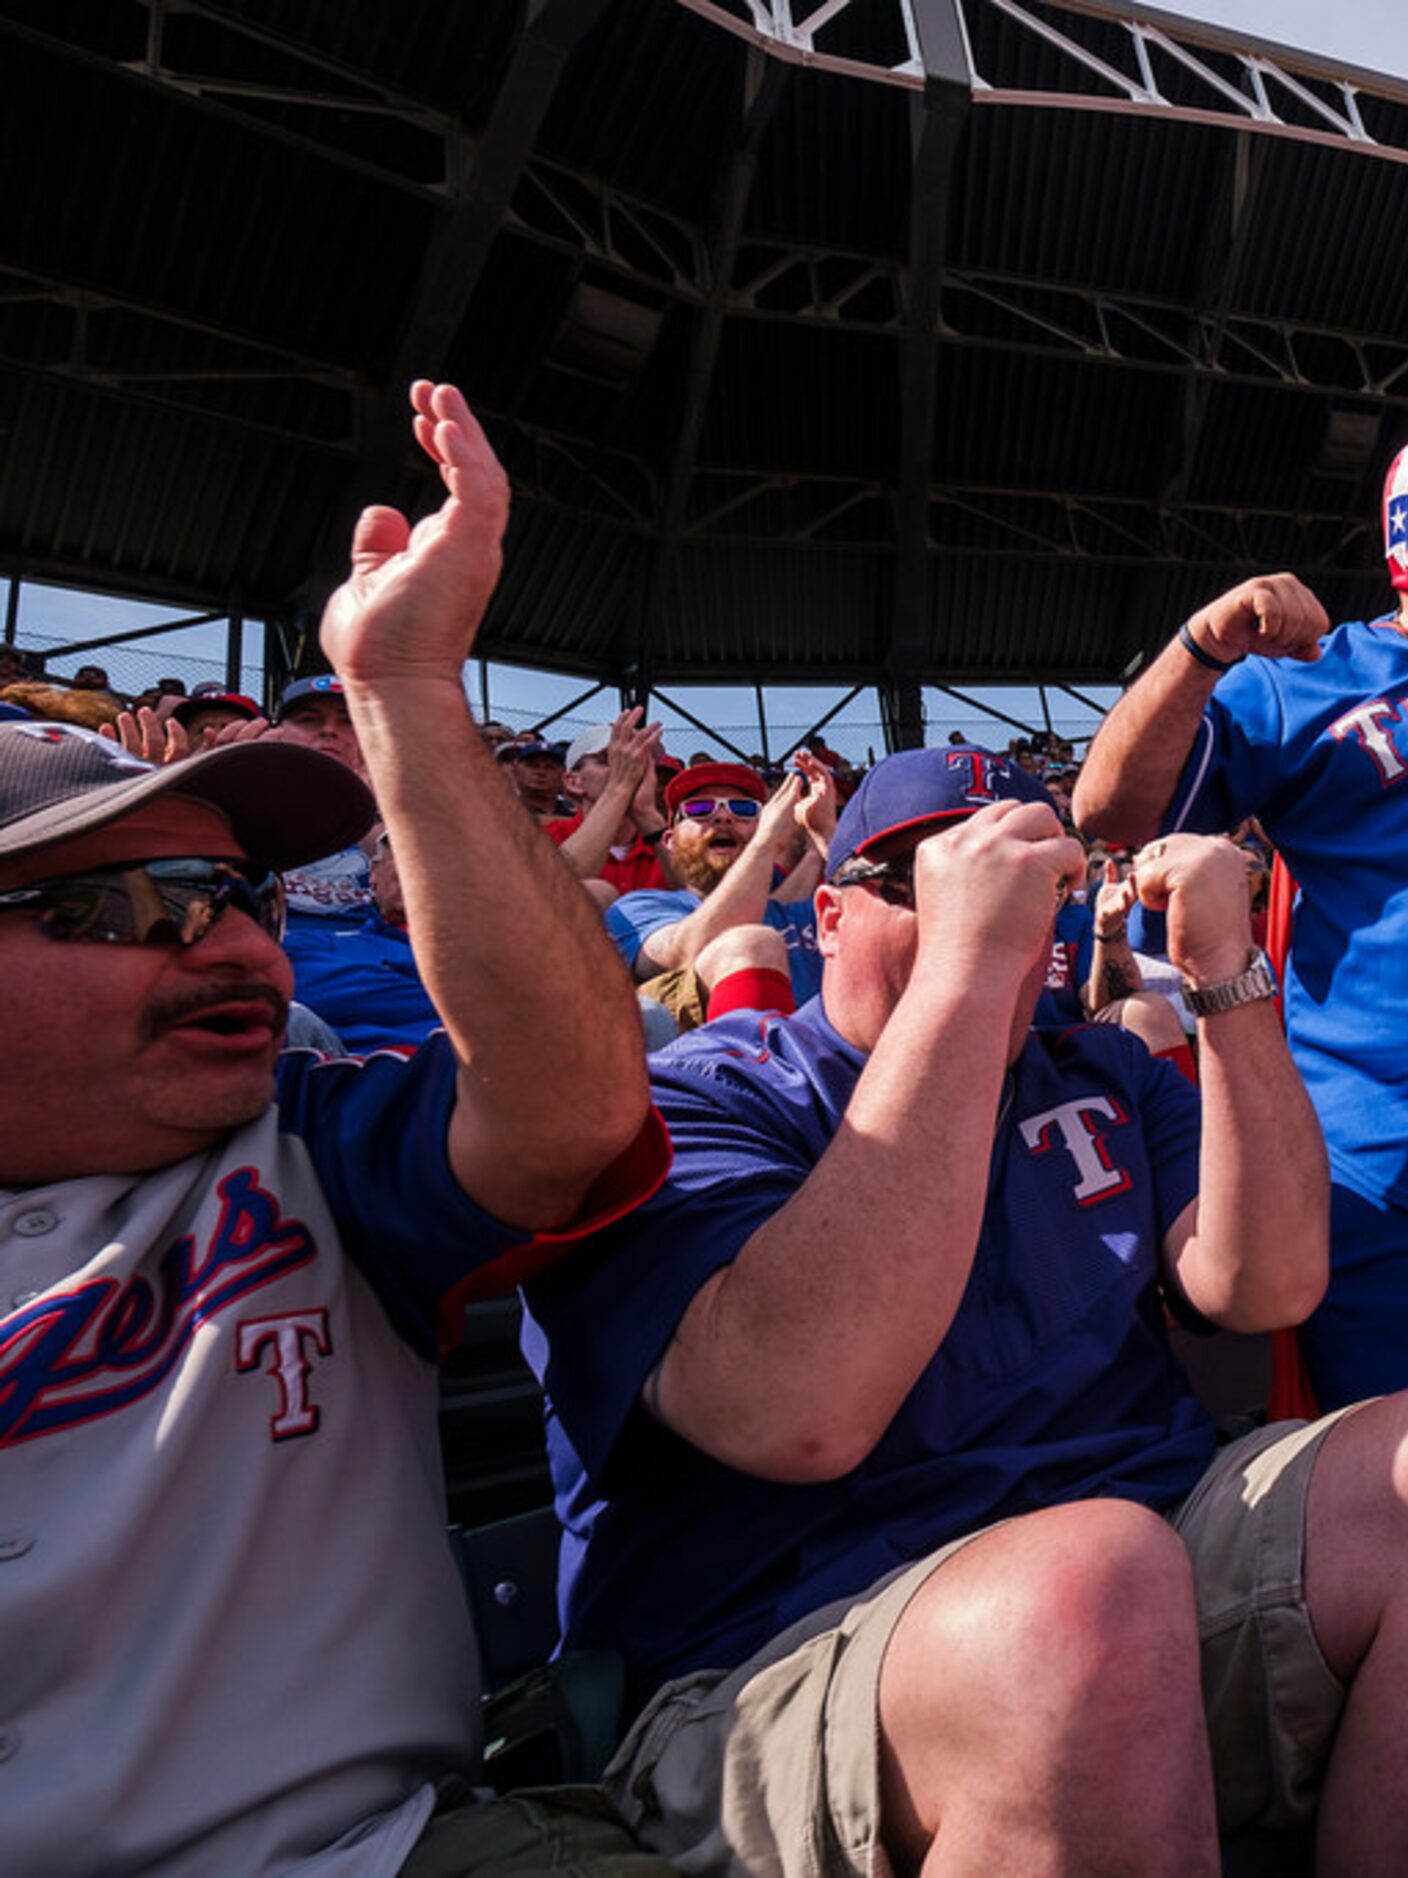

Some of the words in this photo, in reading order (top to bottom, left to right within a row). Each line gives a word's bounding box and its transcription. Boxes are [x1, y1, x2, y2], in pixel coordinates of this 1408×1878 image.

[945, 751, 1010, 804] T
[1018, 1096, 1133, 1207] T
[235, 1307, 333, 1443] T
